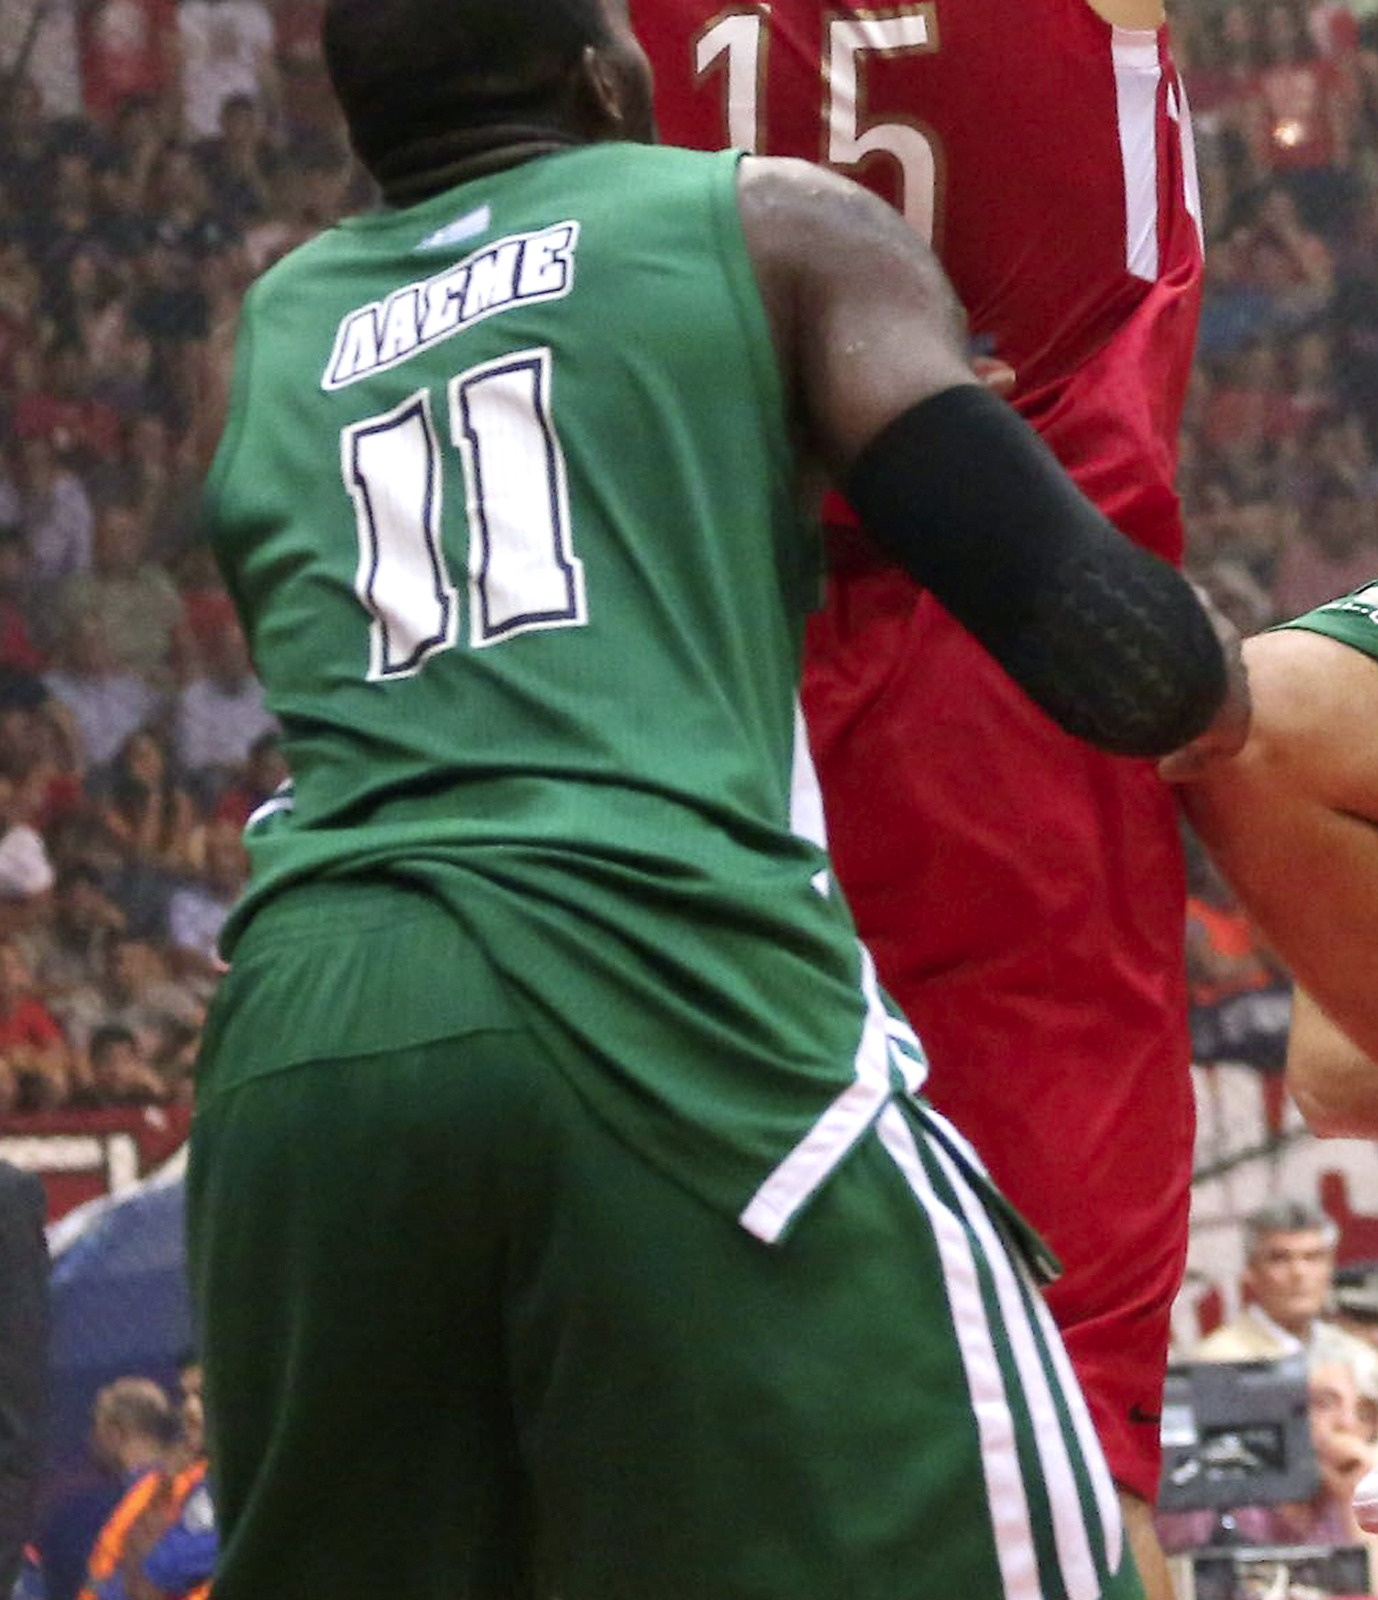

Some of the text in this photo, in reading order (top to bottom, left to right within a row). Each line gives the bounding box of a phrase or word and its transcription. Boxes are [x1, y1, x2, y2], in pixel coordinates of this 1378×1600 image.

[692, 2, 946, 248] 15
[322, 220, 580, 391] ΛΑΣΜΕ
[341, 347, 588, 682] 11
